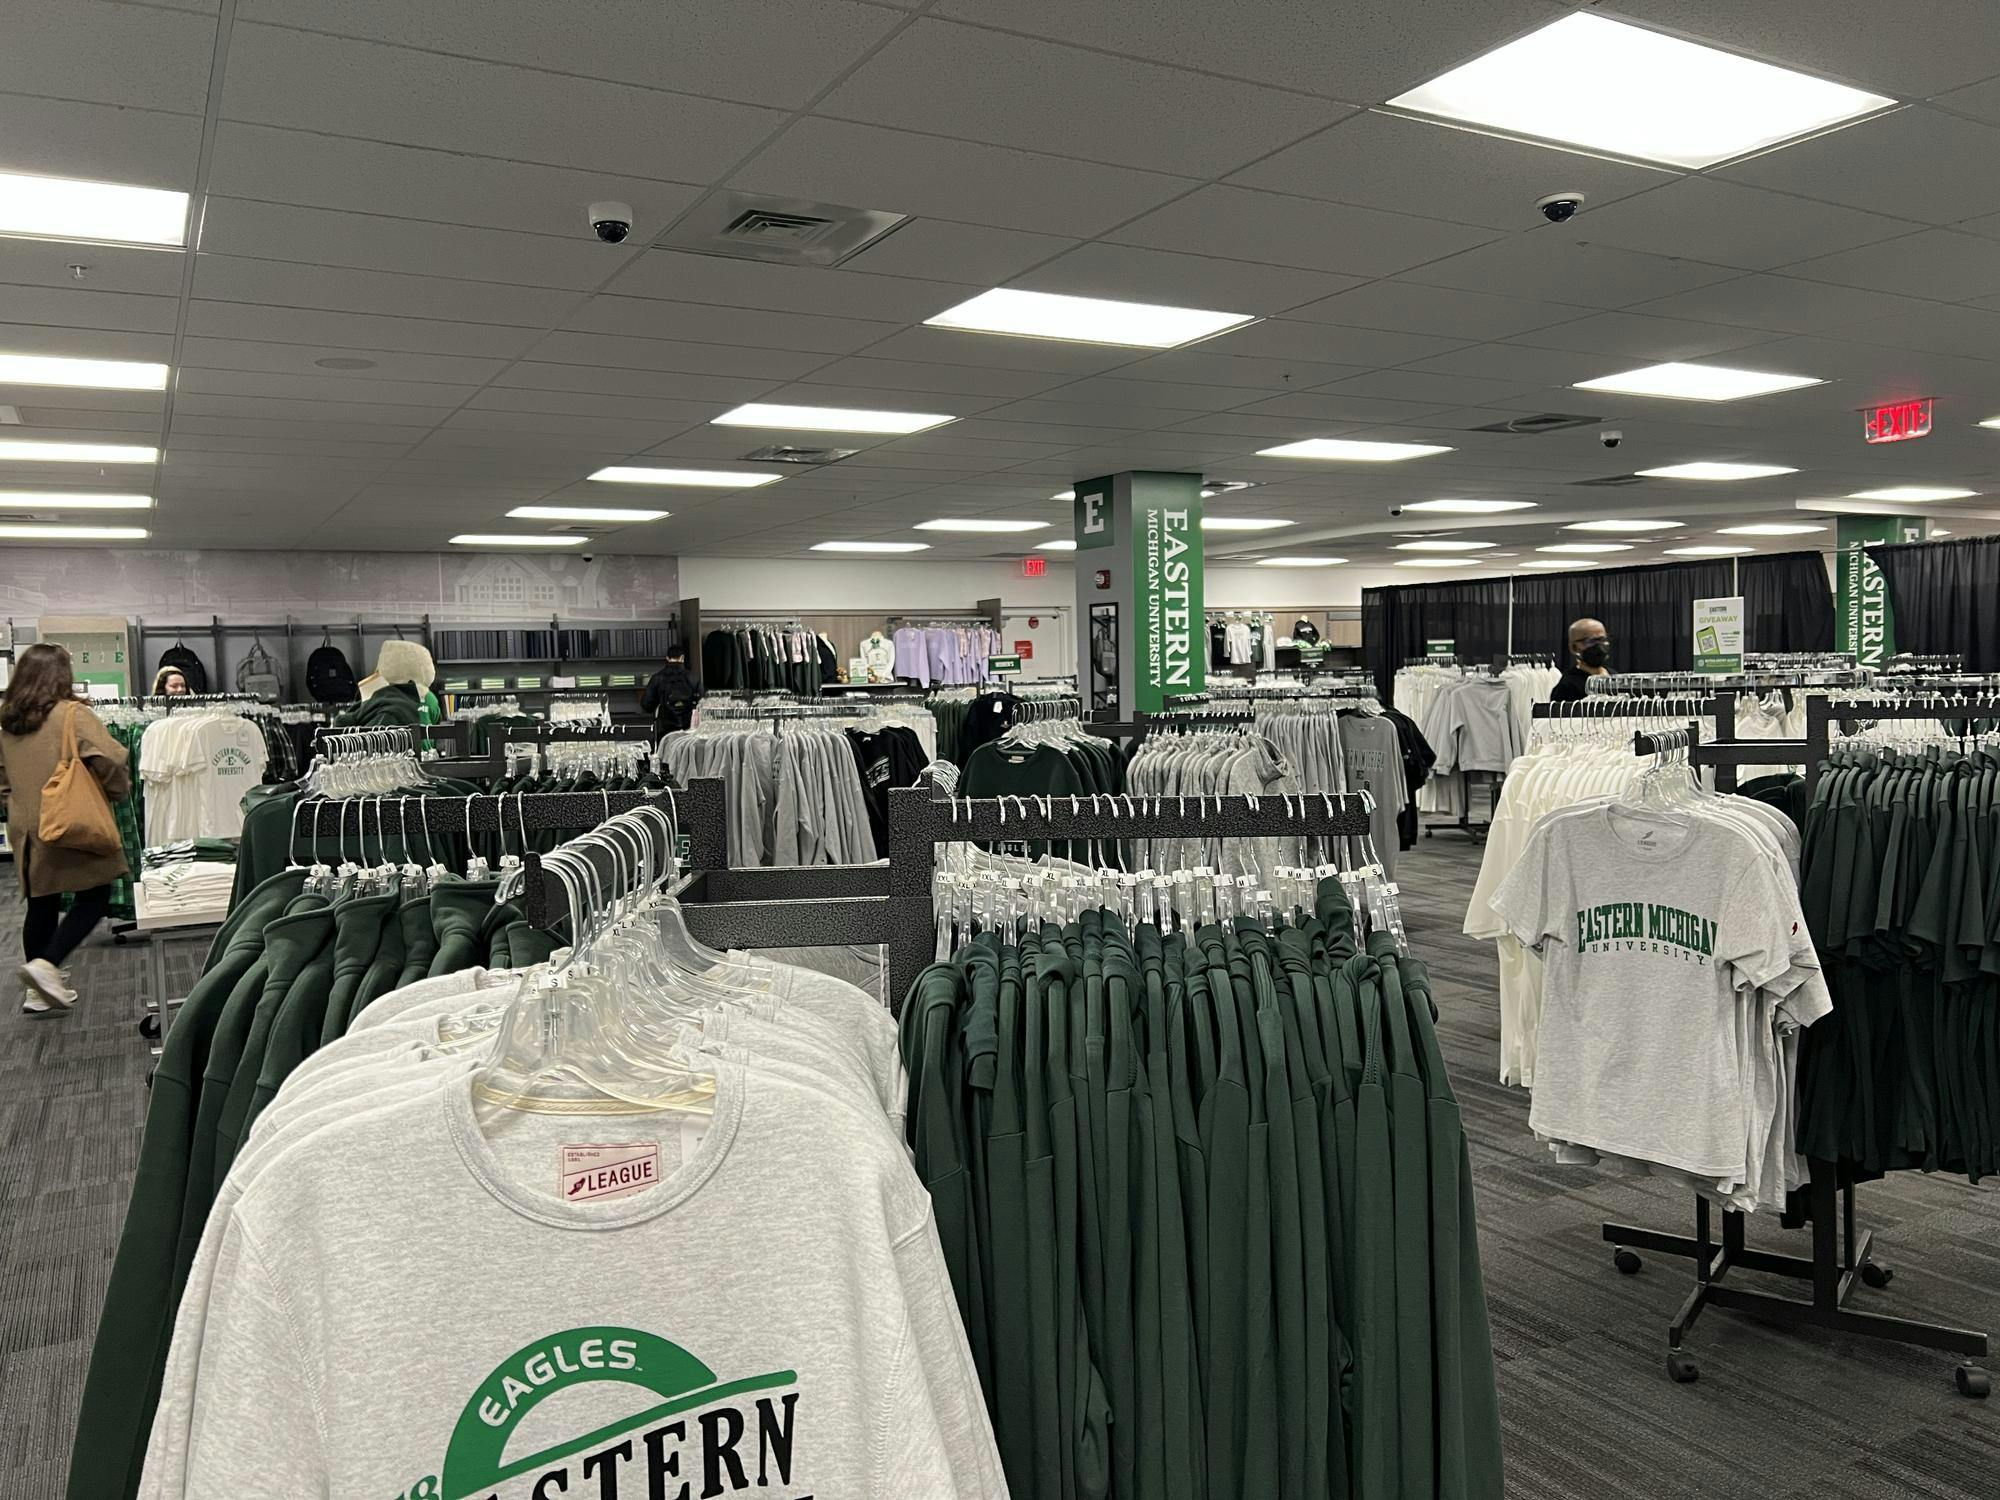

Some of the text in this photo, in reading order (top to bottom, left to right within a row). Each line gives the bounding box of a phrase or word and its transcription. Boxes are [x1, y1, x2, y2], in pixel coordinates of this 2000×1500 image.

[1876, 403, 1921, 437] EXIT
[1083, 492, 1105, 534] E
[1026, 560, 1045, 576] EXIT
[1147, 509, 1161, 688] MICHIGAN UNIVERSITY
[1163, 508, 1190, 688] EASTERN
[1699, 615, 1738, 624] GIVEAWAY
[1848, 601, 1859, 655] UNIVERSI
[211, 748, 252, 767] EASTERN MICHIGAN
[1577, 903, 1644, 953] EASTERN
[1592, 940, 1706, 966] UNIVERSITY
[551, 978, 558, 987] S
[588, 1161, 652, 1191] LEAGUE
[478, 1339, 638, 1427] EAGLES
